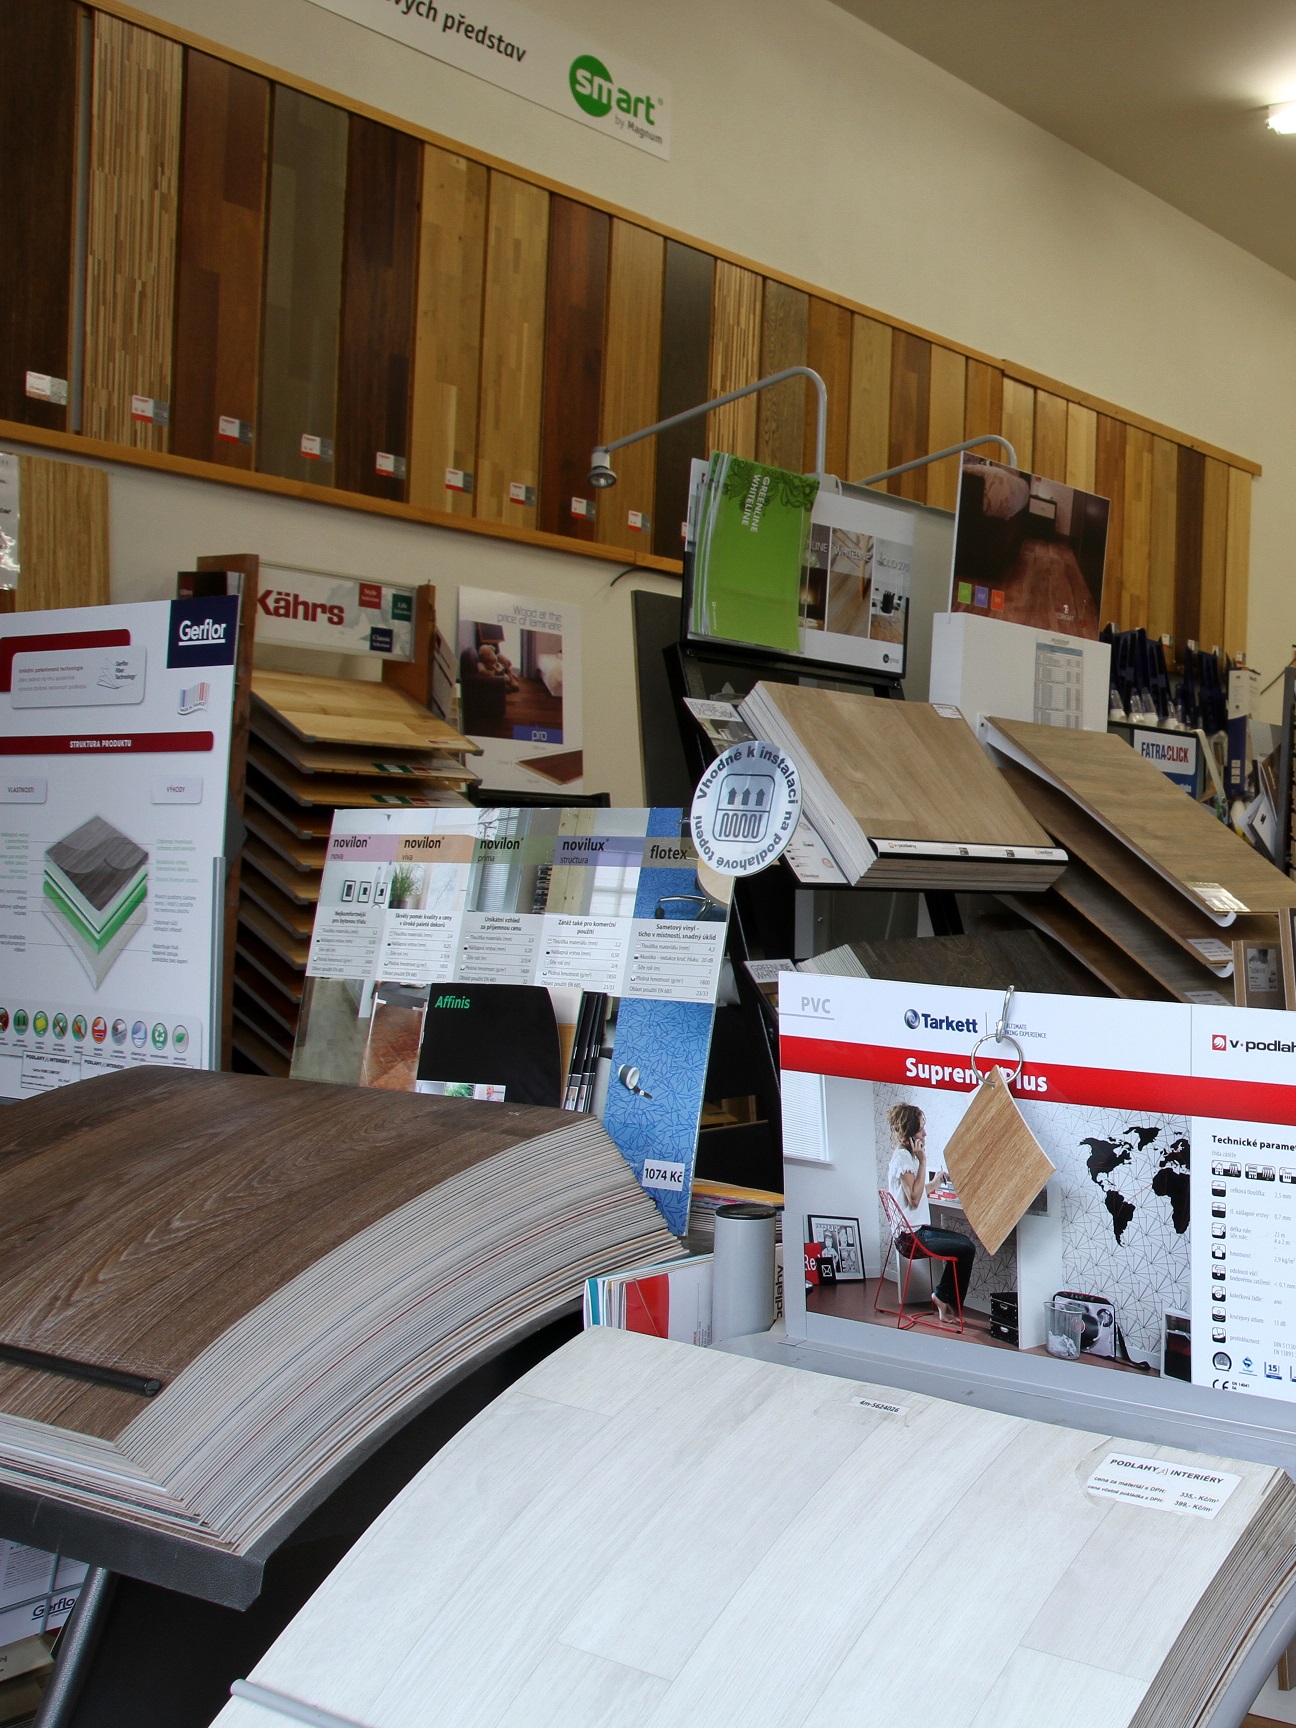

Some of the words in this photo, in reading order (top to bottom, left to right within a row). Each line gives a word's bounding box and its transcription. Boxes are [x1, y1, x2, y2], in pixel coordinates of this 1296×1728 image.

[442, 13, 526, 62] představ
[574, 68, 656, 126] smart
[615, 114, 624, 128] by
[627, 120, 662, 144] Magnum
[742, 474, 762, 526] WHITELINE
[750, 476, 770, 532] GREENLINE
[256, 589, 344, 626] Kährs
[512, 605, 536, 618] Wood
[548, 612, 562, 622] the
[180, 618, 226, 640] Gerflor
[528, 618, 562, 631] laminate
[532, 730, 548, 742] pro
[70, 740, 101, 748] STRUKTURA
[746, 746, 756, 758] k
[697, 749, 742, 800] Vhodné
[758, 747, 798, 804] instalaci
[166, 785, 185, 793] VÝHODY
[780, 811, 792, 831] na
[333, 837, 368, 848] novilon
[404, 838, 442, 849] novilon
[480, 838, 520, 850] novilon
[562, 838, 605, 852] novilux
[692, 816, 714, 862] topení
[402, 853, 413, 861] viva
[478, 854, 495, 863] prima
[650, 844, 688, 860] flotex
[716, 832, 782, 870] podlahové
[560, 856, 588, 864] structura
[593, 920, 616, 928] komerční
[656, 924, 682, 932] Sametový
[682, 924, 696, 932] vinyl
[434, 994, 470, 1010] Affinis
[800, 996, 832, 1014] PVC
[922, 1012, 978, 1034] Tarkett
[1212, 1135, 1258, 1148] Technické
[644, 1168, 668, 1182] 1074
[670, 1171, 684, 1183] Kč
[1268, 1364, 1278, 1372] 15
[860, 1400, 900, 1412] 4m-5624026
[1110, 1458, 1159, 1472] PODLAHY
[1170, 1470, 1224, 1484] INTERIÉRY
[1118, 1481, 1144, 1489] materiál
[33, 1597, 75, 1616] Gerflo
